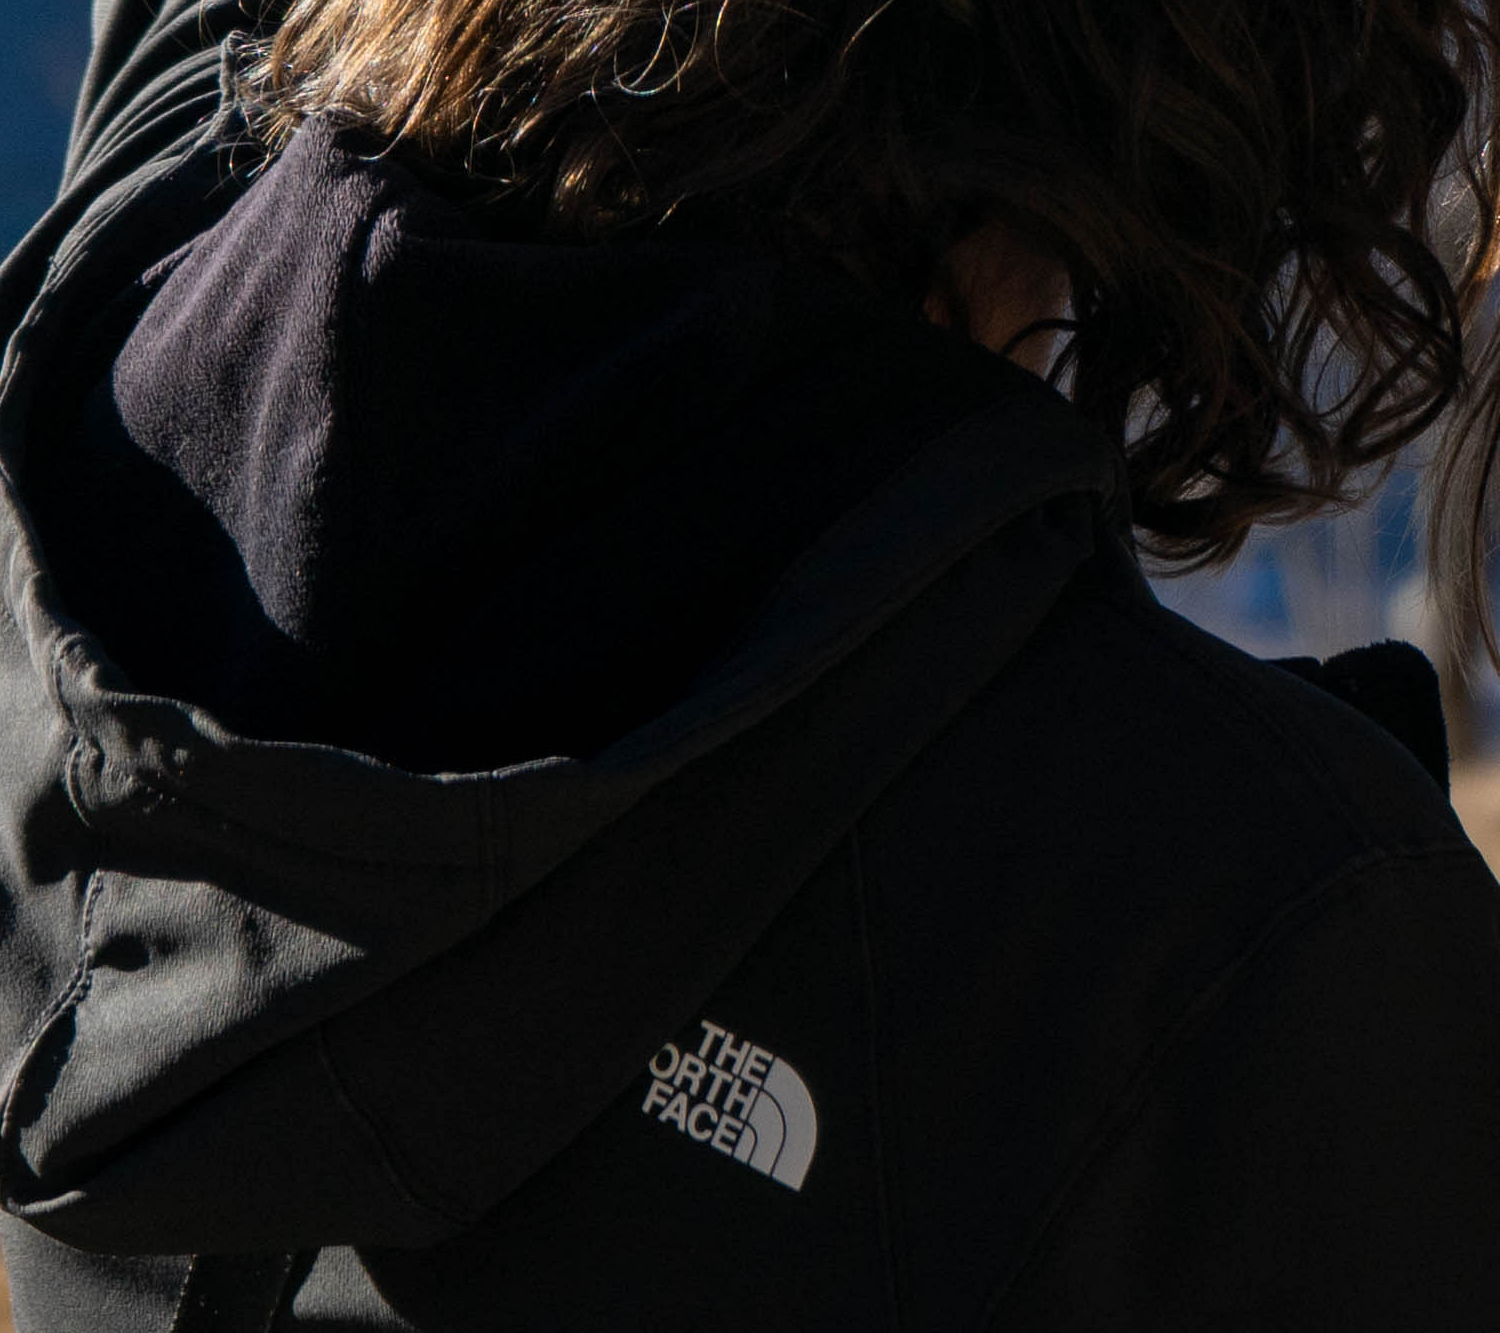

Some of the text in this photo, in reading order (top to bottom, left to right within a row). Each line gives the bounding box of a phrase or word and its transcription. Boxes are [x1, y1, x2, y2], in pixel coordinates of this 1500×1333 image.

[649, 1043, 759, 1120] ORTH
[699, 1020, 773, 1085] THE
[642, 1079, 744, 1155] FACE
